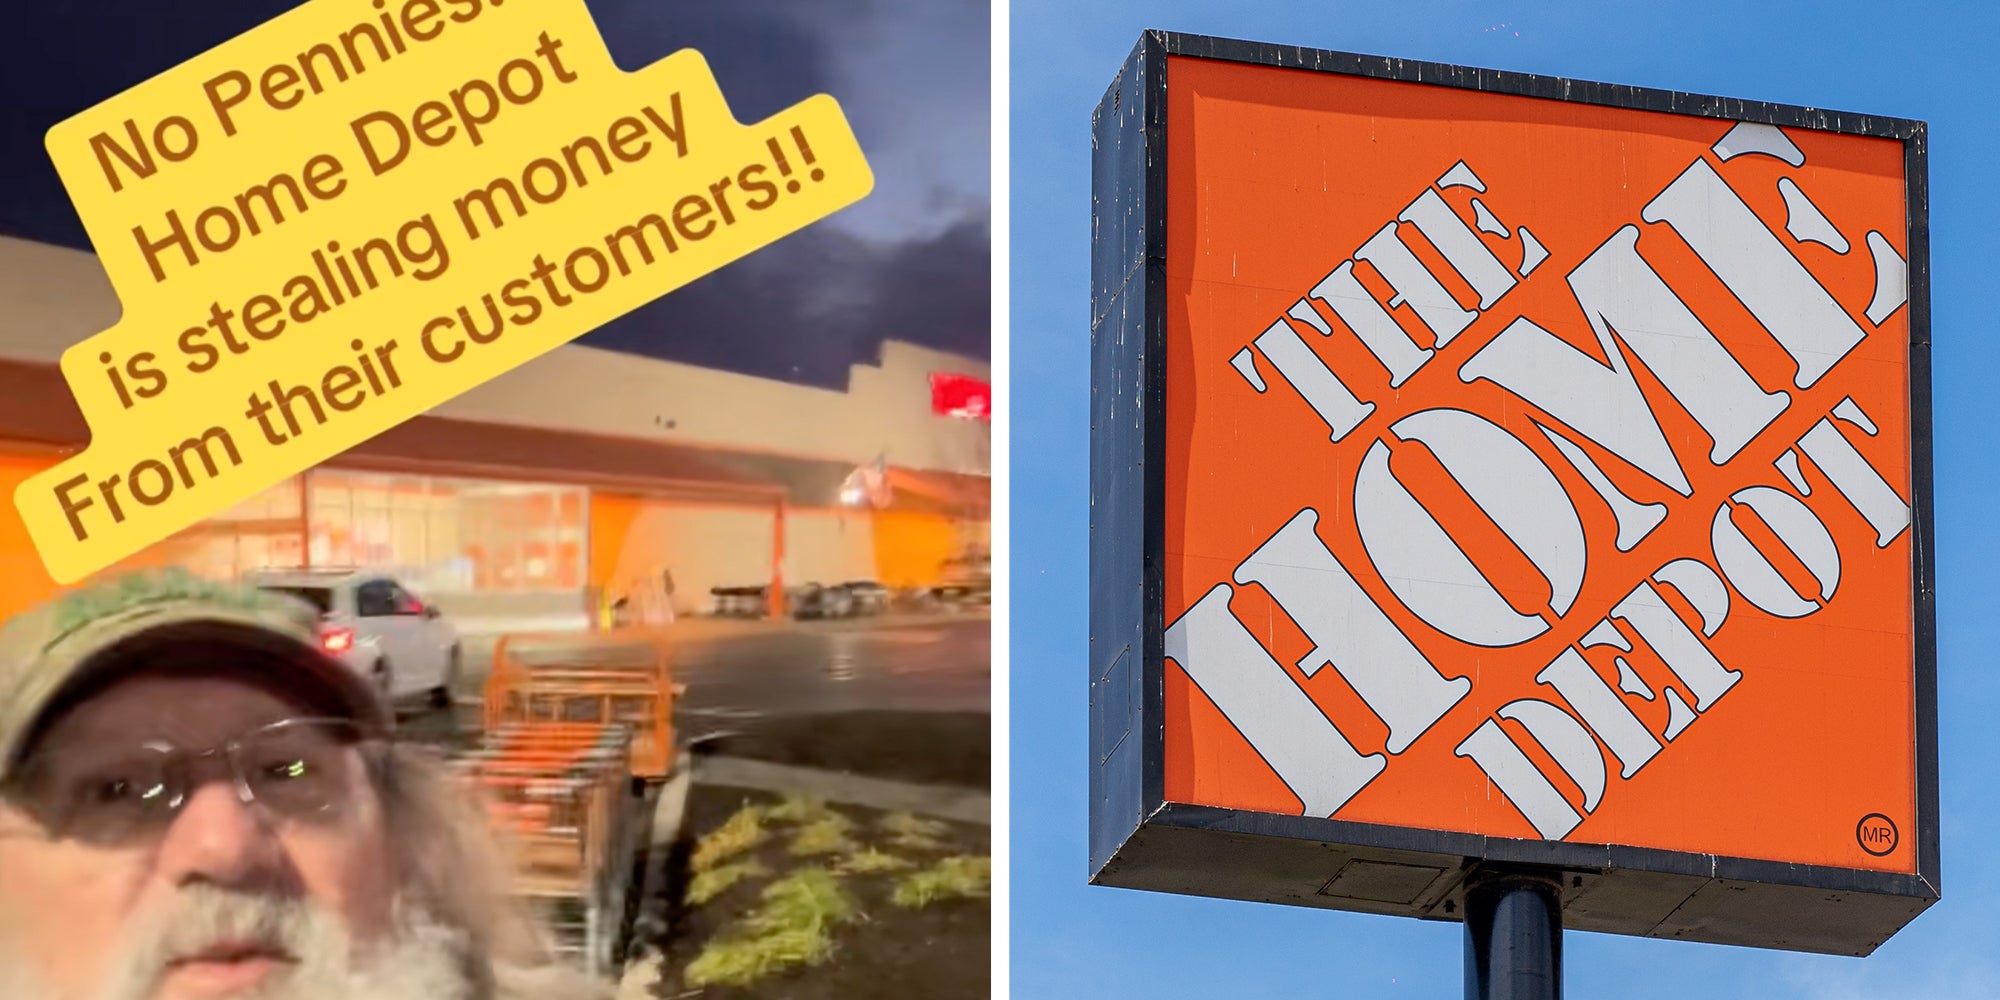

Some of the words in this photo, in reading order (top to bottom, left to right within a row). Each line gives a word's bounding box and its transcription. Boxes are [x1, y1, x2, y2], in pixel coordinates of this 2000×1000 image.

[1165, 121, 1908, 818] HOME
[1229, 160, 1551, 443] THE
[1455, 396, 1911, 842] DEPOT
[1863, 826, 1892, 844] MR
